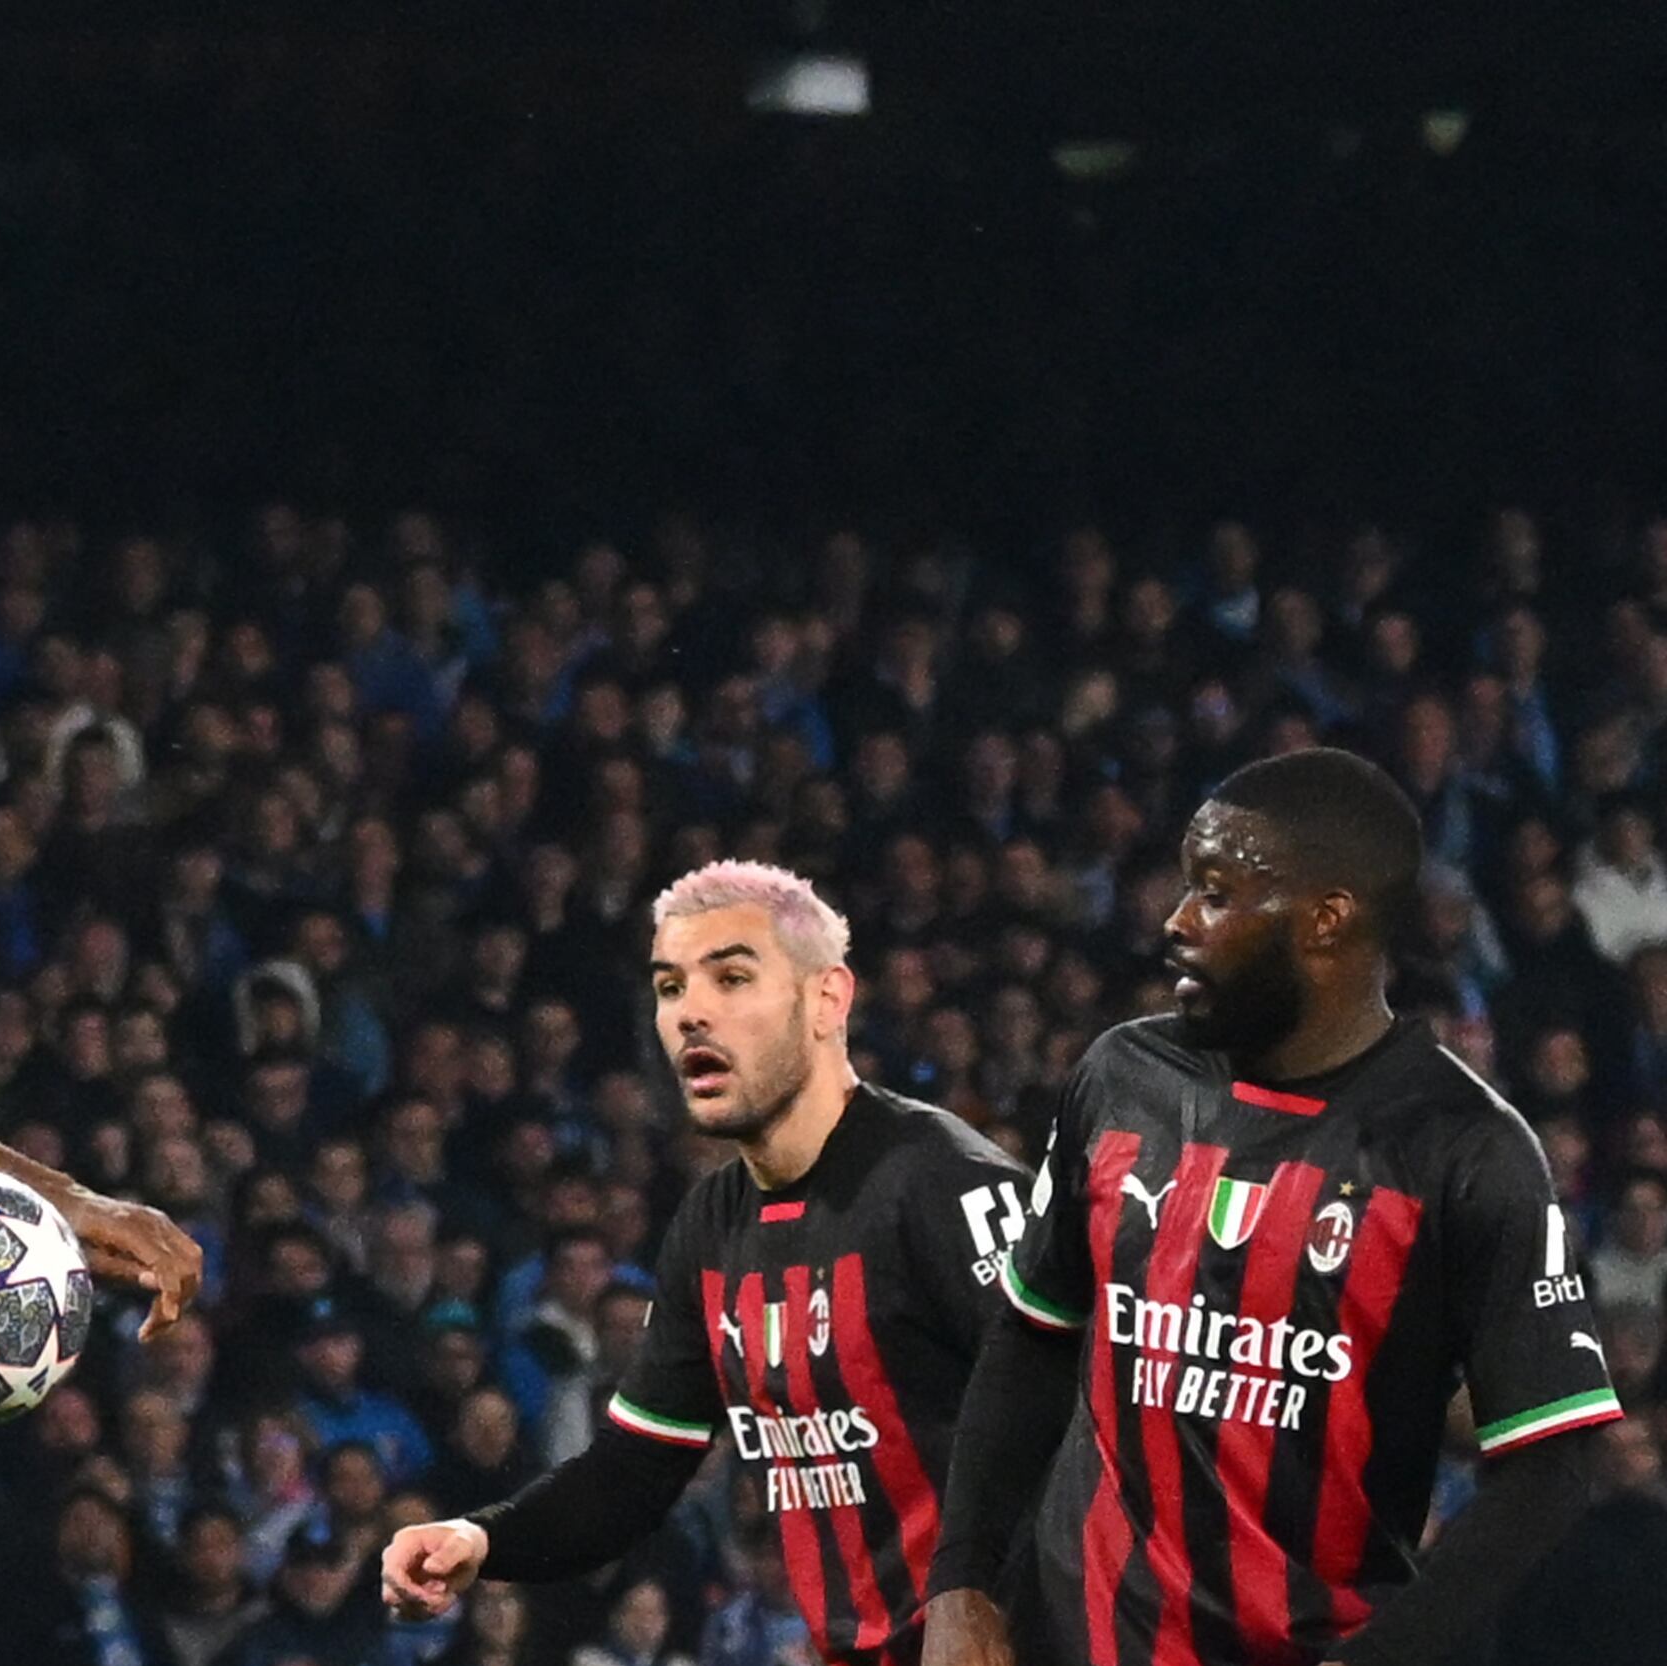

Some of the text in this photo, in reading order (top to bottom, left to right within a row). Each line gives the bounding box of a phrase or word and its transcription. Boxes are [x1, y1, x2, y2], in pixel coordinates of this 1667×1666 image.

[1104, 1282, 1353, 1382] Emirates
[1131, 1357, 1307, 1430] FLY BETTER
[727, 1405, 879, 1460] Emirates
